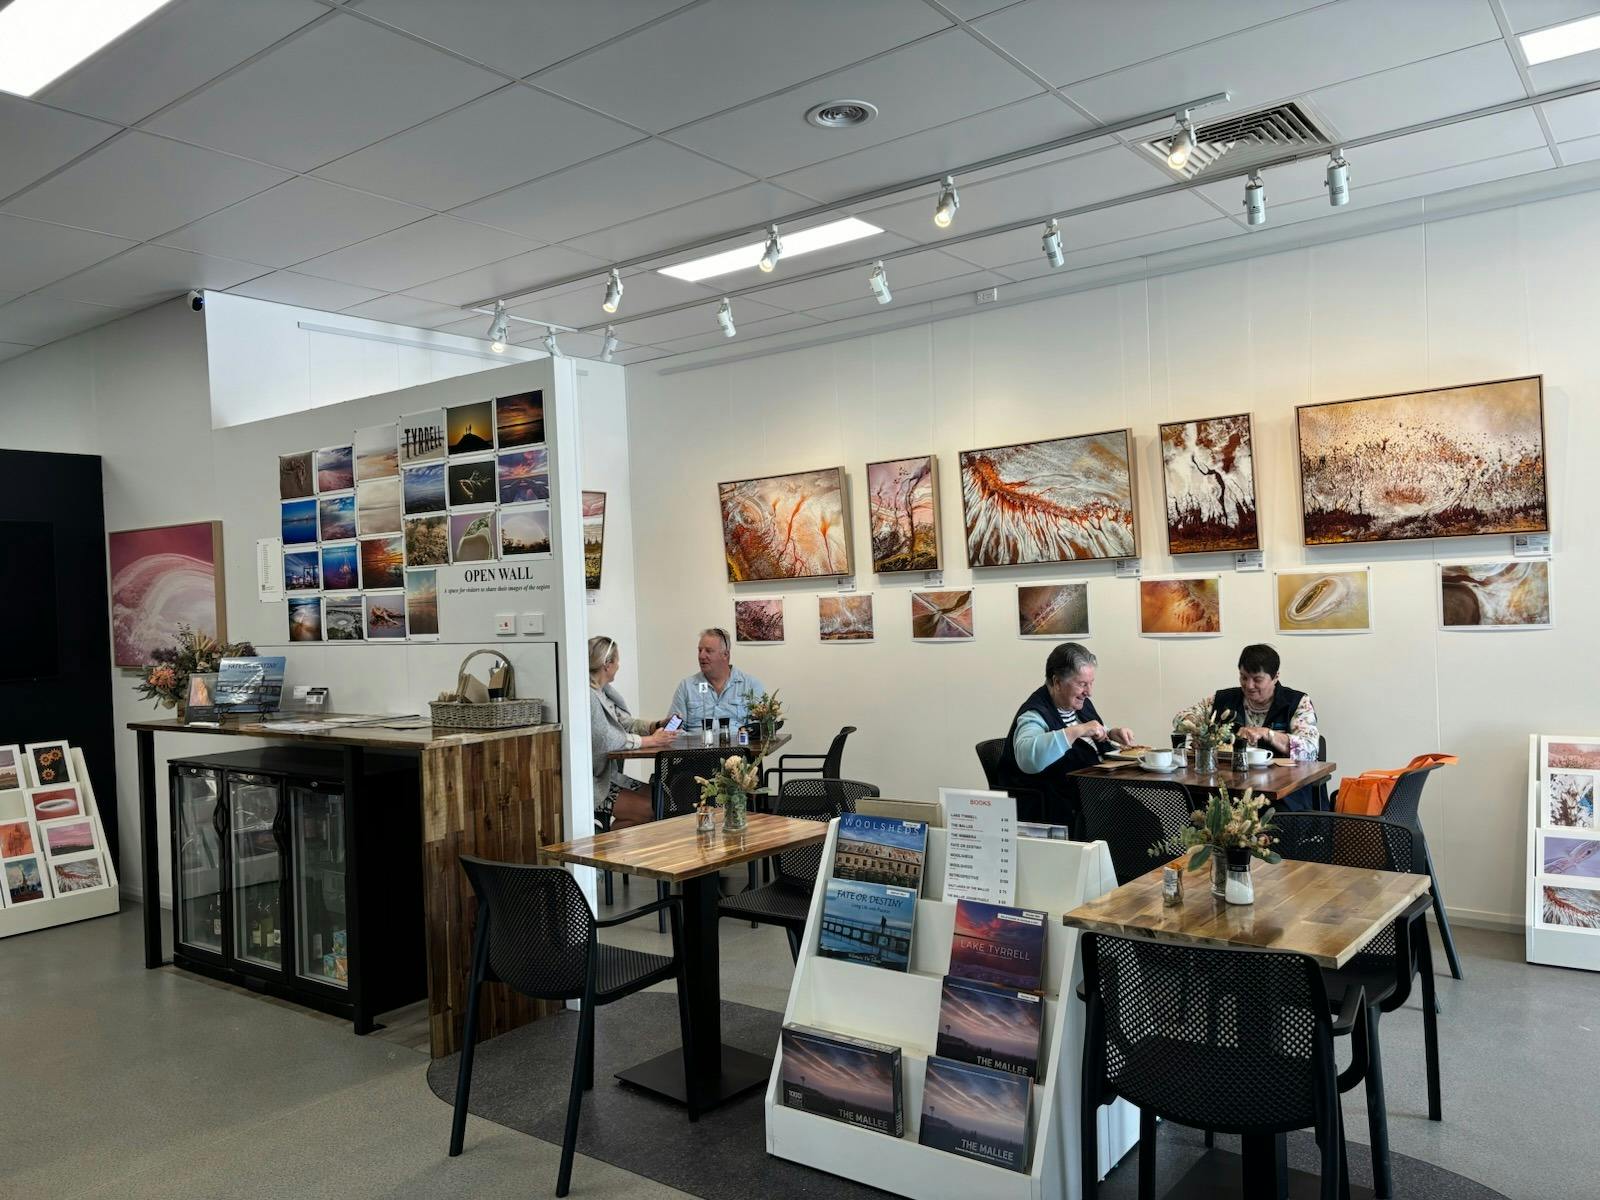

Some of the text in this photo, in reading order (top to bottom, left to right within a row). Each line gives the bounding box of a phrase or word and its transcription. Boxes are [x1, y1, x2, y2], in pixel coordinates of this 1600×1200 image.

[464, 566, 534, 582] OPEN WALL
[844, 818, 920, 834] WOOLSHEDS
[836, 890, 904, 908] FATE OR DESTINY
[960, 940, 986, 952] LAKE
[988, 944, 1030, 961] TYRRELL
[976, 1056, 1028, 1076] THE MALLEE
[838, 1108, 854, 1120] THE
[856, 1112, 888, 1130] MALLEE
[960, 1138, 977, 1151] THE
[980, 1144, 1014, 1161] MALLEE
